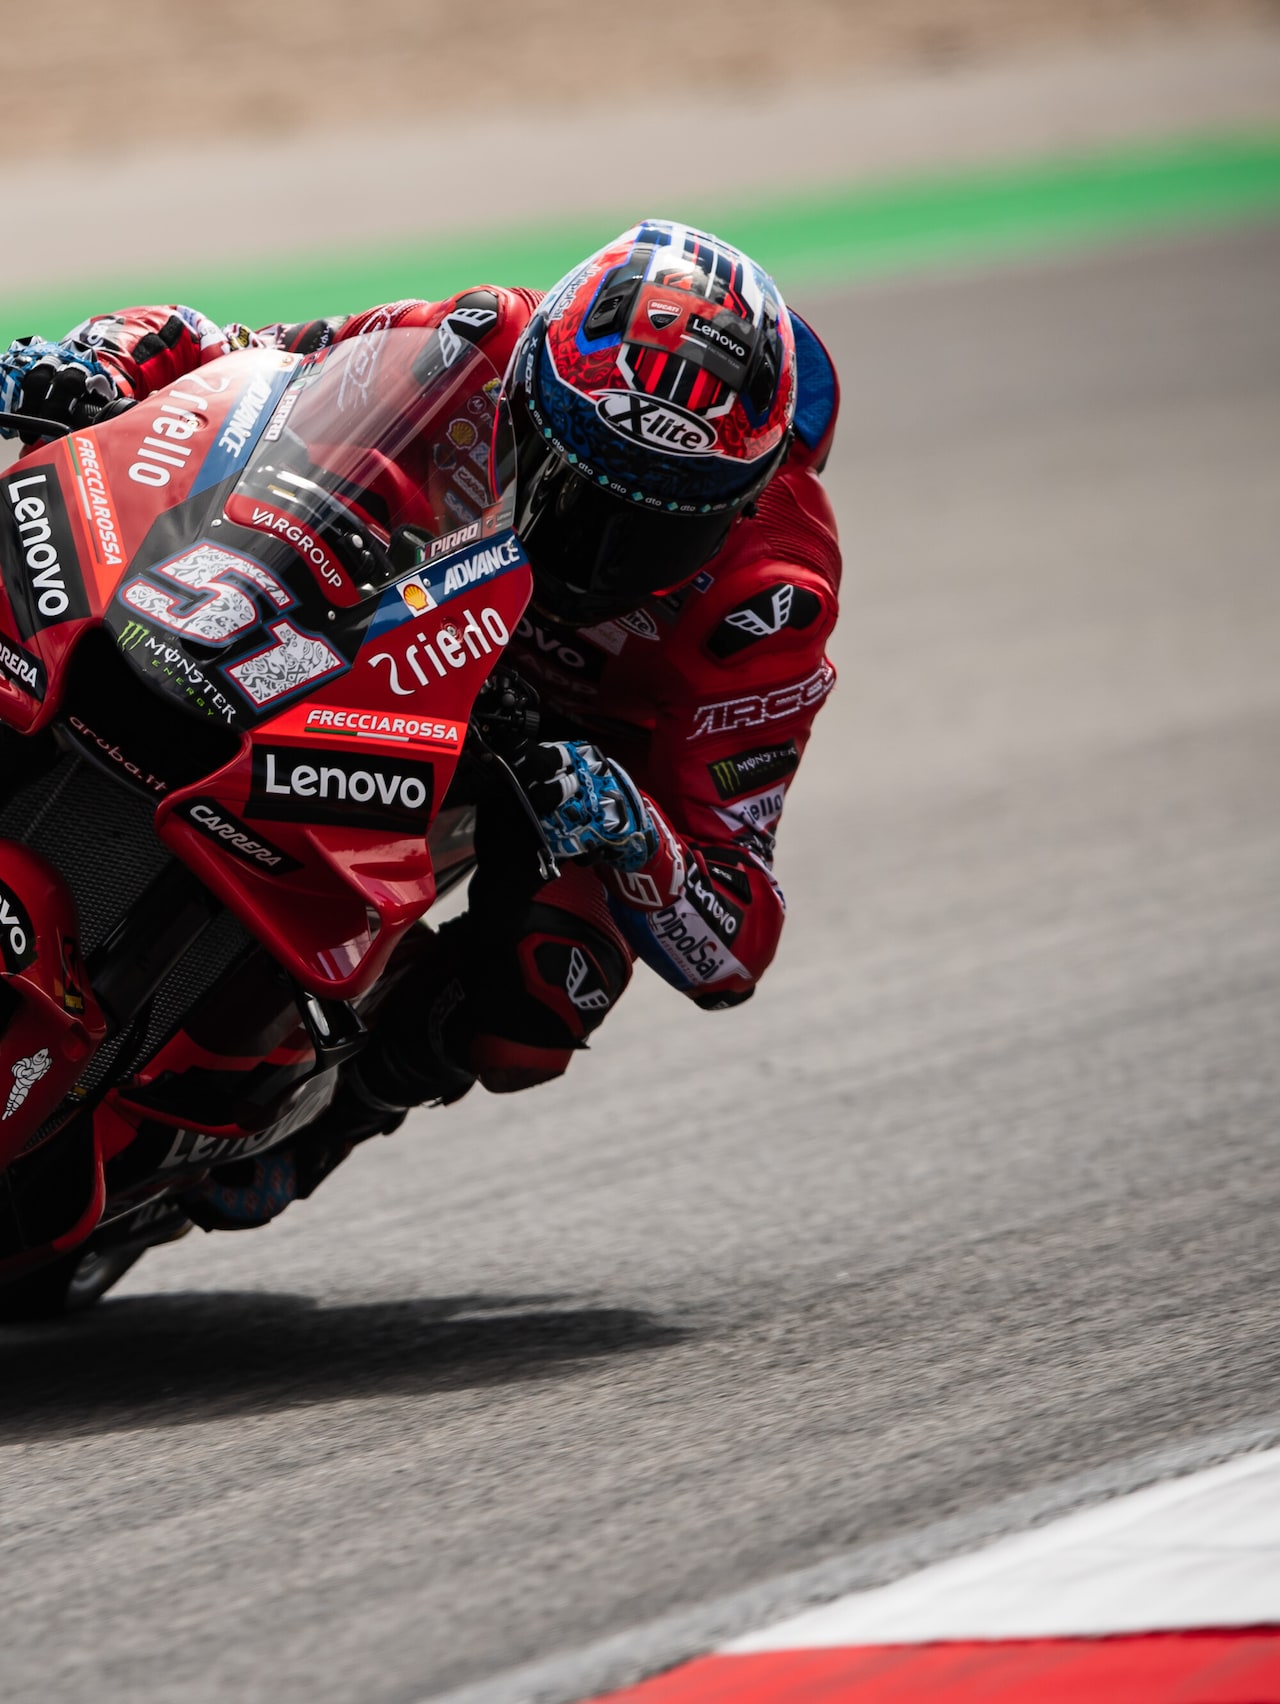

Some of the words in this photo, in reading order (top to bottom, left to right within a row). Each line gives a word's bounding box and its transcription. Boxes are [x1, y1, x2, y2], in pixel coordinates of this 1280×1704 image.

[651, 301, 680, 313] DUCATI
[692, 318, 745, 357] Lenovo
[218, 376, 273, 458] ADVANCE
[607, 393, 703, 450] X-lite
[75, 436, 123, 566] FRECCIAROSSA
[7, 474, 69, 617] Lenovo
[251, 507, 344, 589] VARGROUP
[431, 523, 481, 559] PIRRO
[442, 534, 521, 595] ADVANCE
[121, 541, 351, 711] 51
[151, 659, 215, 716] ENERGY
[69, 715, 168, 792] aruba.it
[307, 710, 459, 742] FRECCIAROSSA
[265, 753, 427, 809] Lenovo
[189, 803, 281, 867] CARRERA
[657, 906, 725, 981] nipolSai
